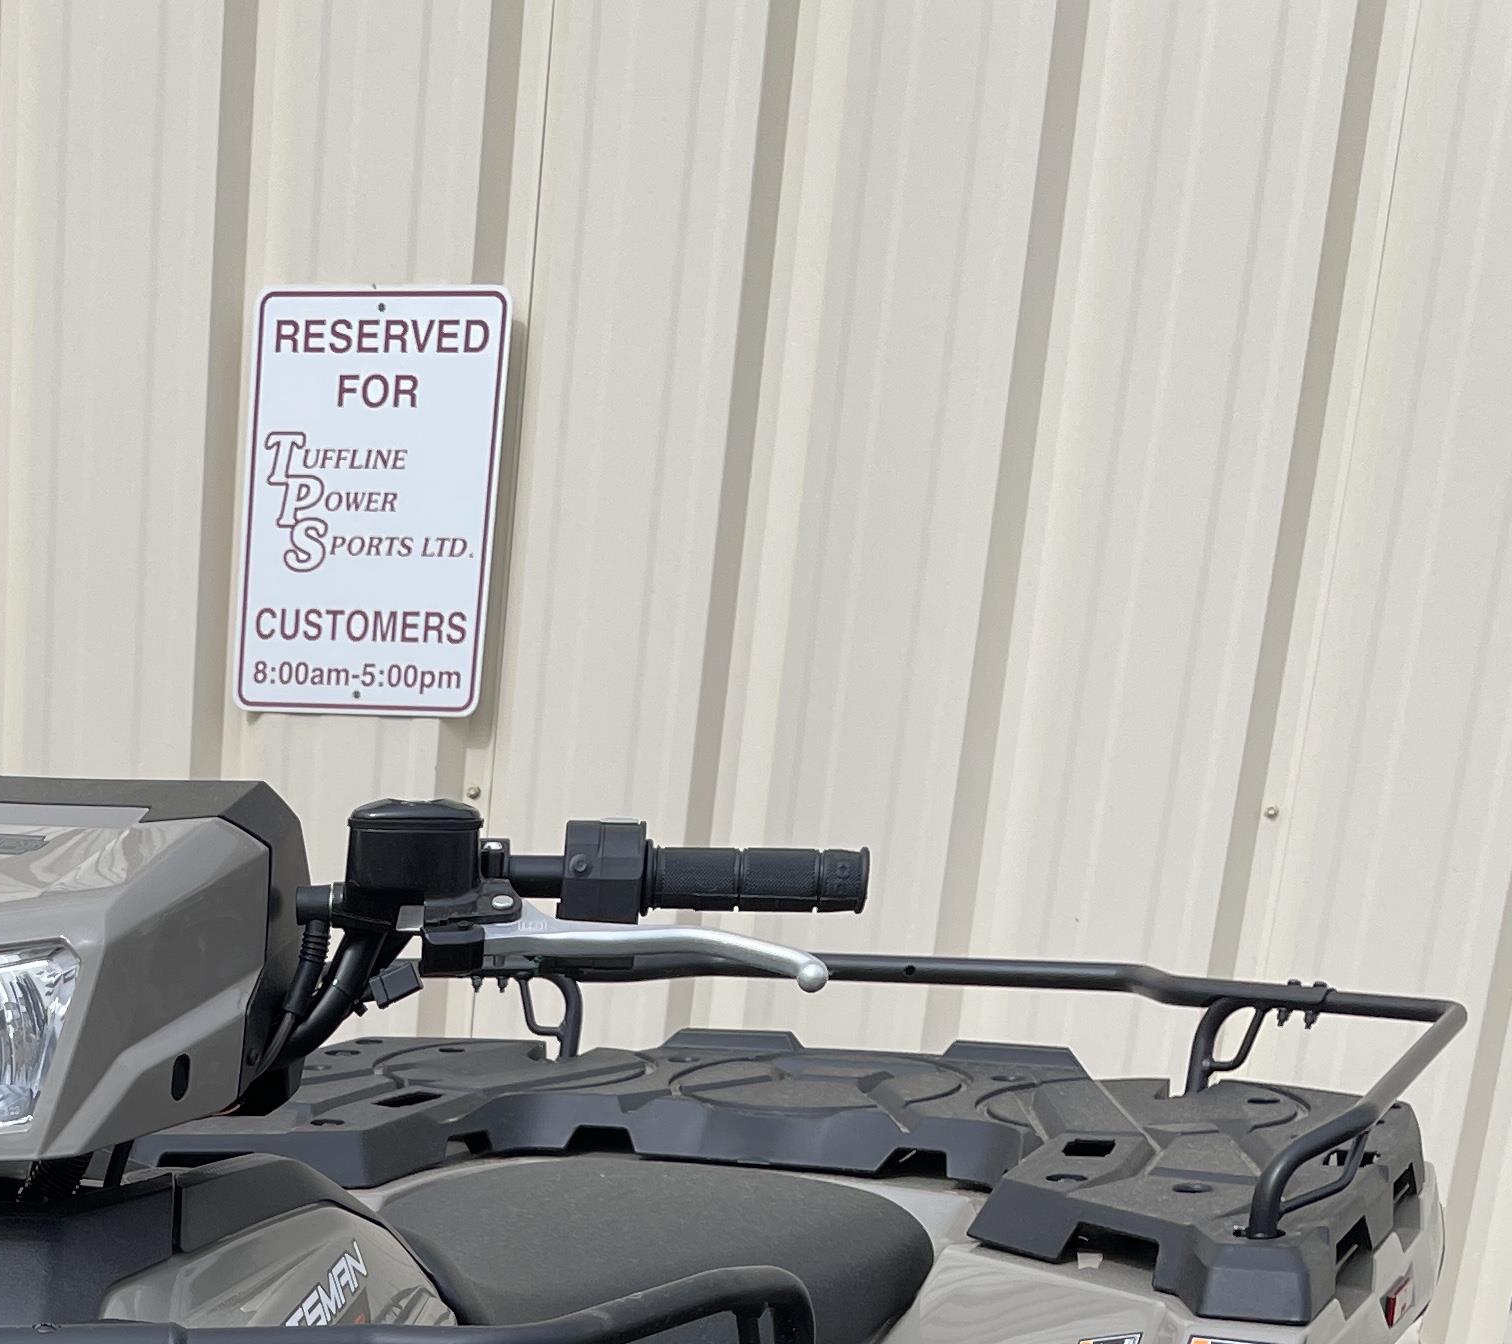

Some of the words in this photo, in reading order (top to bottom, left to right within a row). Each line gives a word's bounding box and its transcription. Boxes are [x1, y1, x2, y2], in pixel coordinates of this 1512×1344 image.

[275, 319, 490, 354] RESERVED
[337, 374, 418, 408] FOR
[265, 431, 408, 485] TUFFLINE
[276, 474, 398, 528] POWER
[283, 517, 414, 572] SPORTS
[421, 536, 475, 559] LTD.
[255, 607, 468, 645] CUSTOMERS
[253, 660, 462, 695] 8:00am-5:00pm
